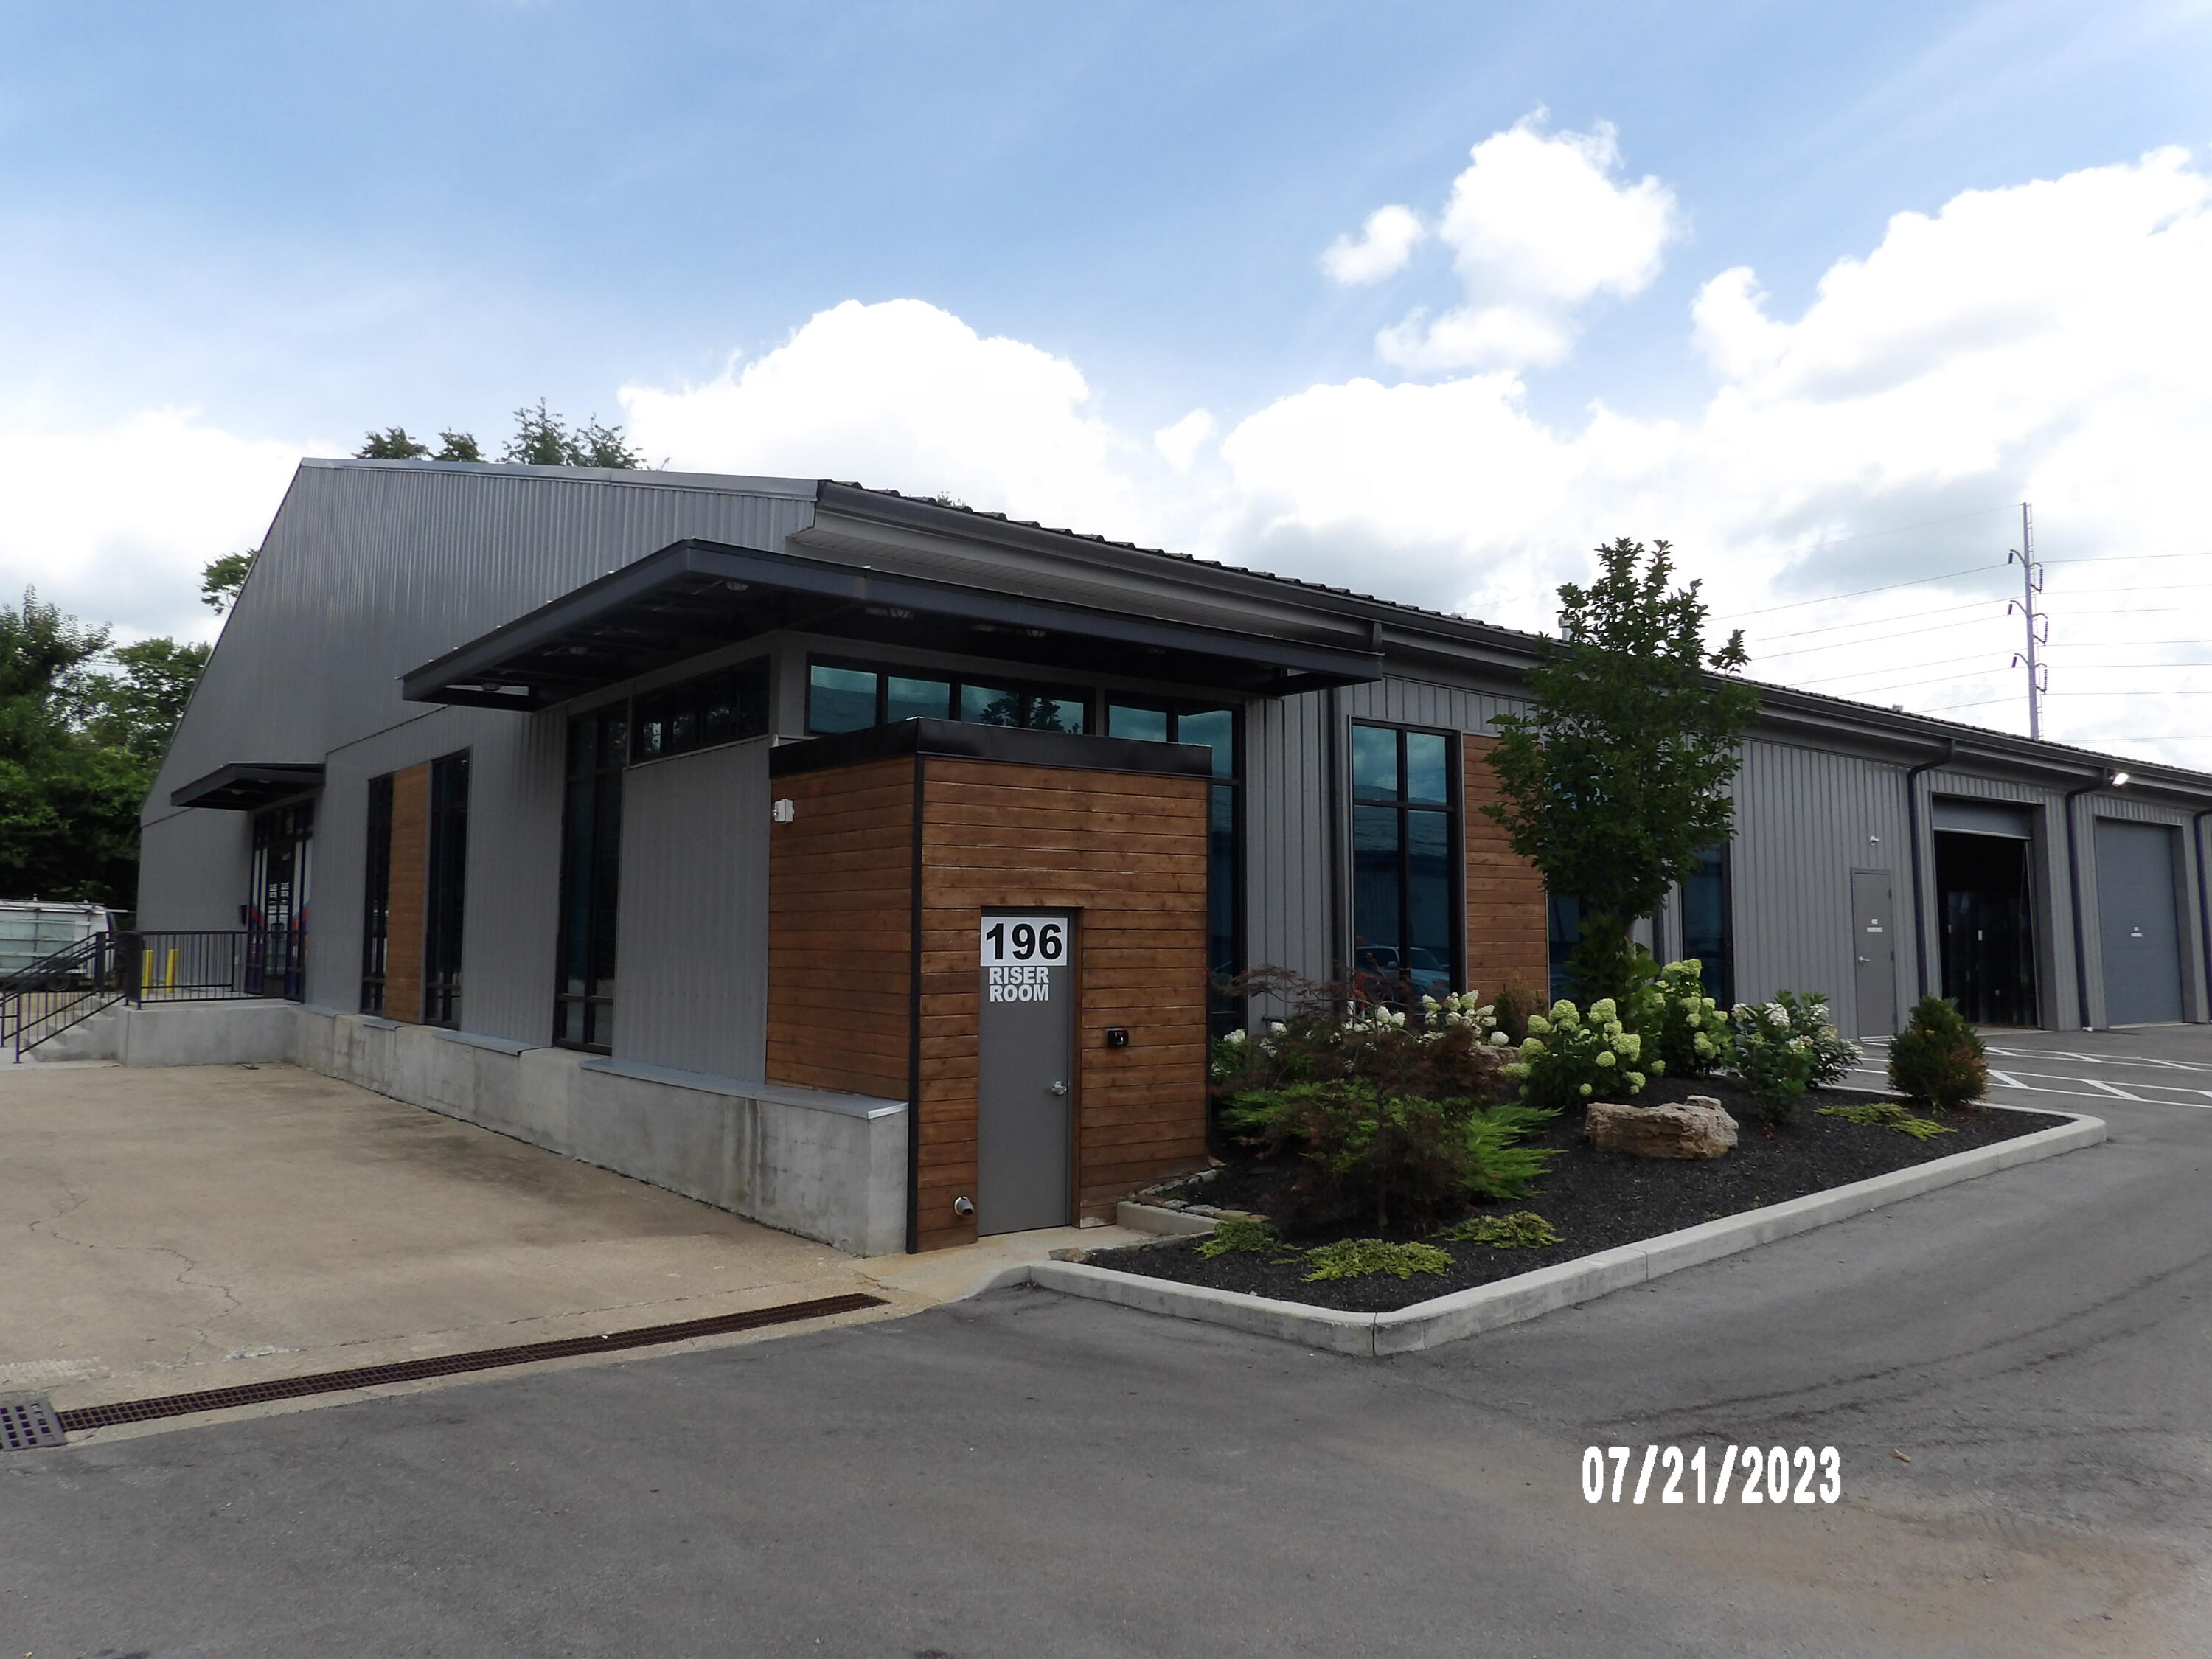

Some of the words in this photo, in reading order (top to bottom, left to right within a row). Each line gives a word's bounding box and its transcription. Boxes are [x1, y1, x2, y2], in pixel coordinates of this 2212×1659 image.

[986, 922, 1062, 961] 196
[989, 967, 1050, 984] RISER
[989, 984, 1049, 1002] ROOM
